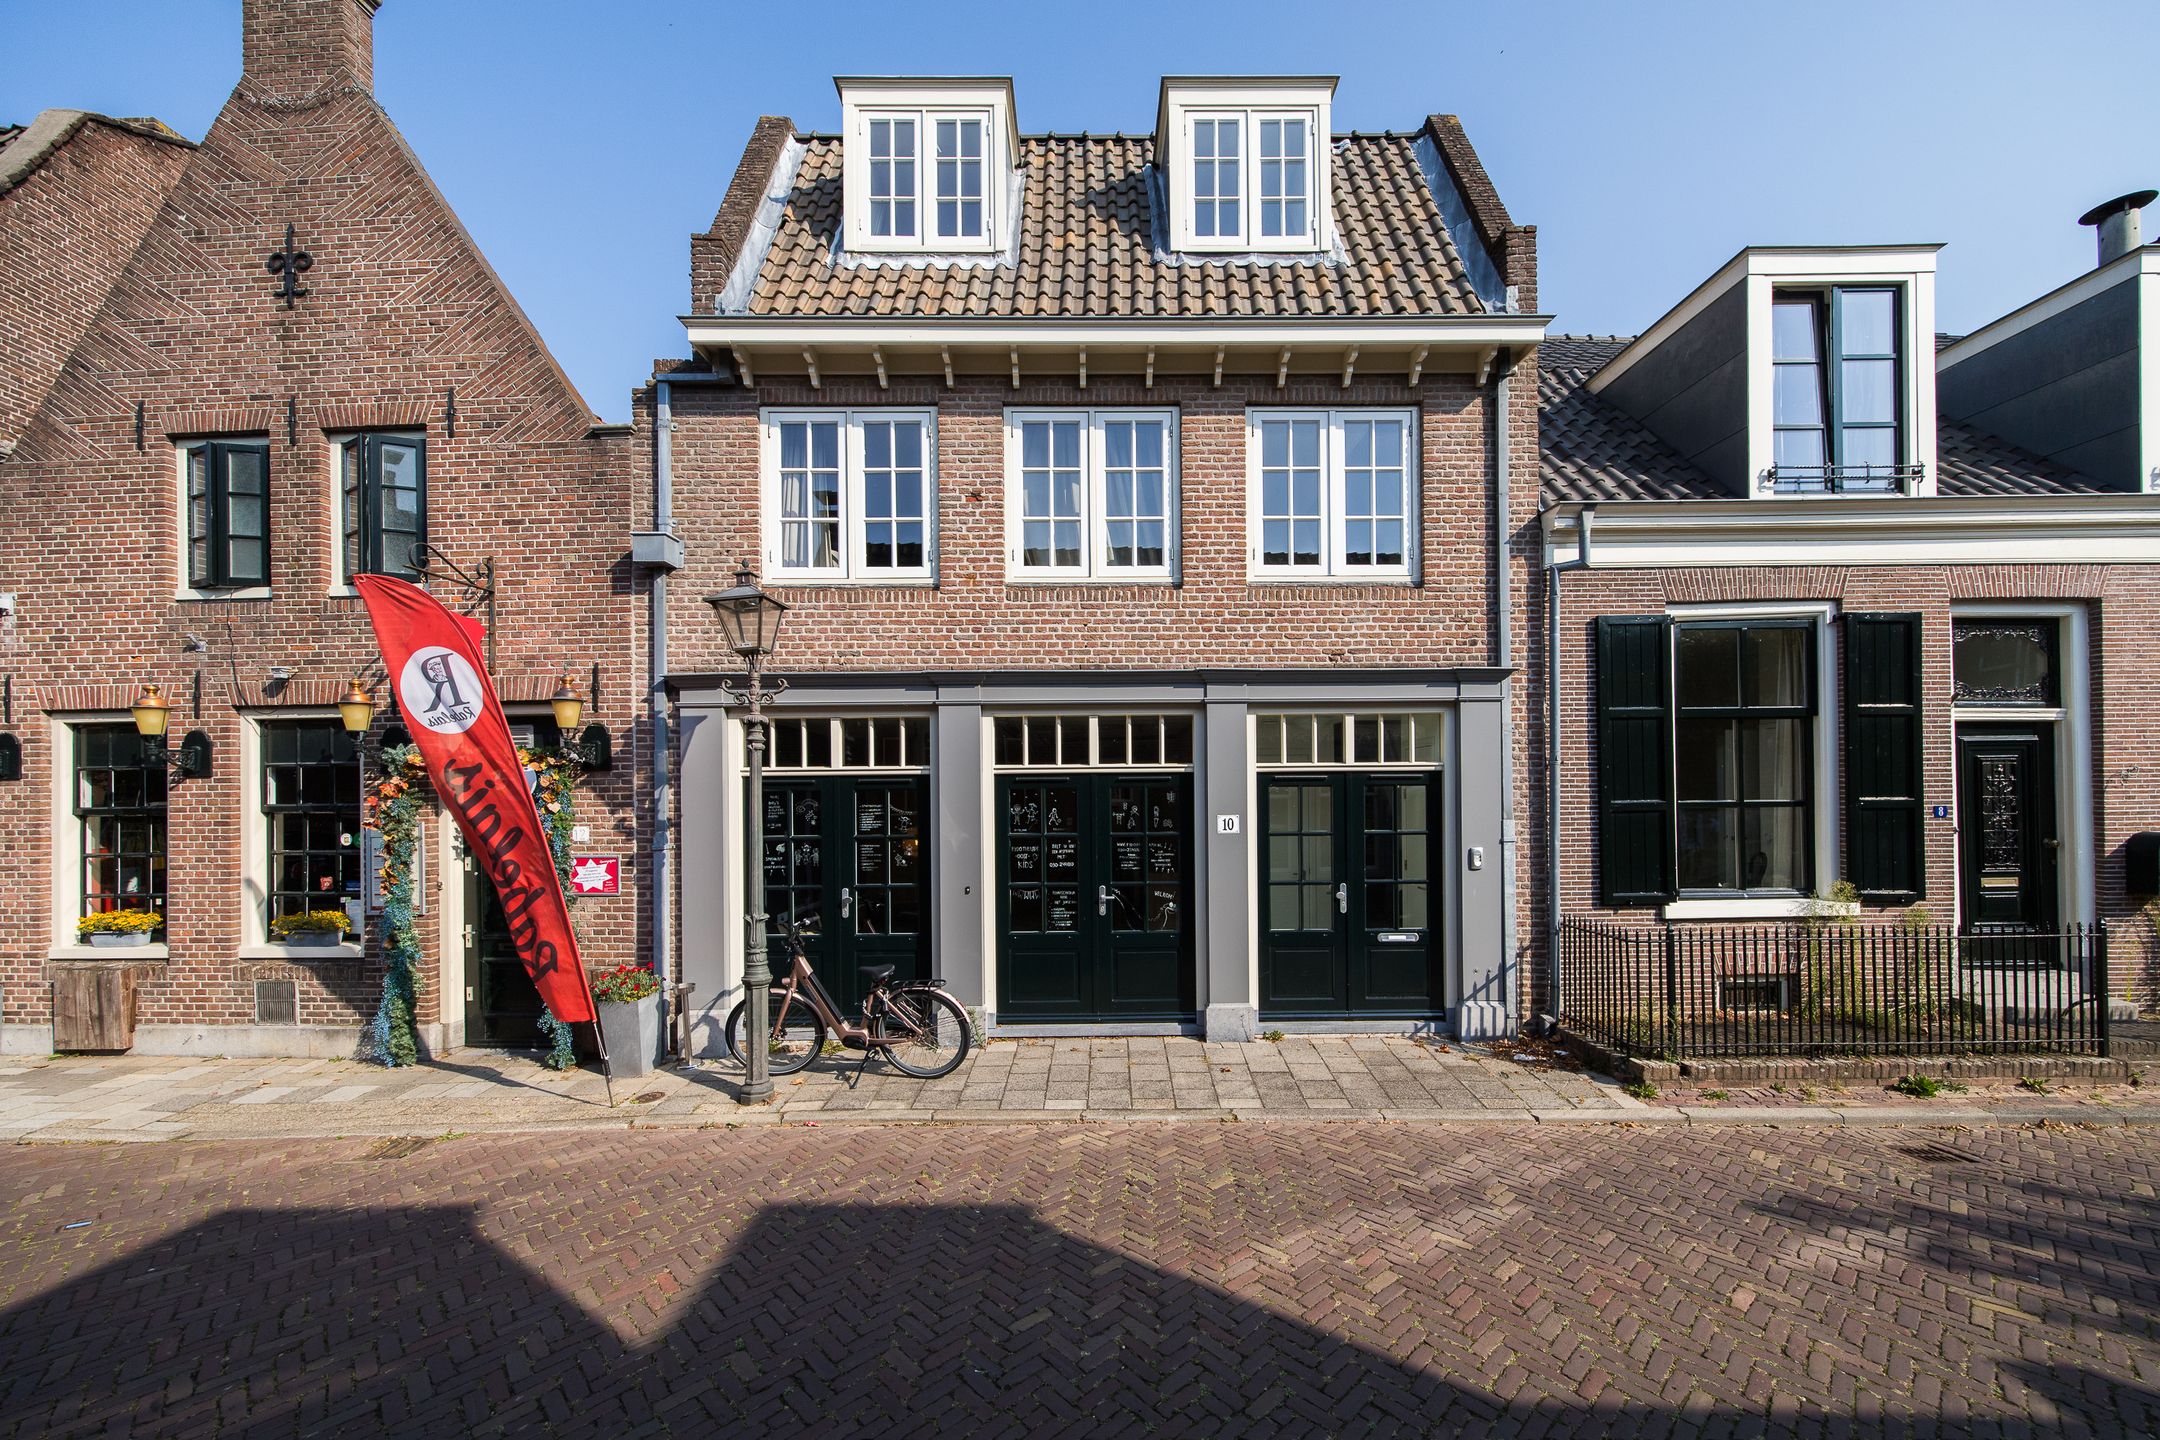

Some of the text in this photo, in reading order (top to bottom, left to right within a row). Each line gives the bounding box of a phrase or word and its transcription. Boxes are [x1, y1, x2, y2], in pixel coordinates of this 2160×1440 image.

[1938, 806, 1944, 817] 8
[1222, 817, 1235, 831] 10
[1017, 860, 1034, 869] KIDS
